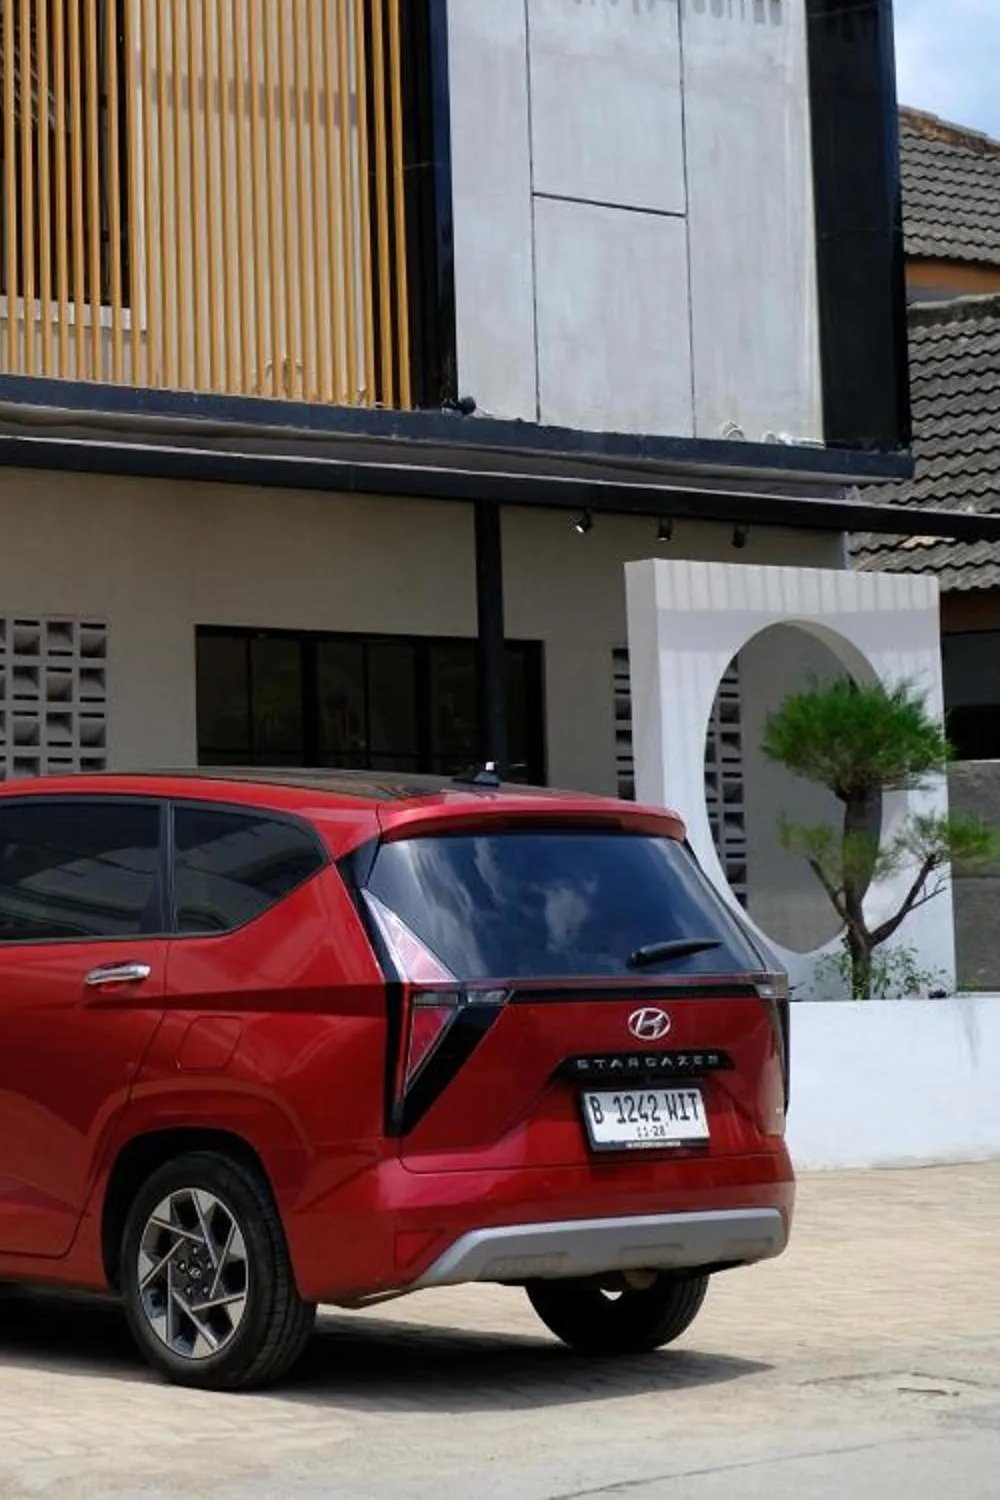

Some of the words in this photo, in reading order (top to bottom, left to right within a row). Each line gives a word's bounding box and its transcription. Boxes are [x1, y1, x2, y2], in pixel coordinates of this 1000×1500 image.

[576, 1055, 719, 1069] STARGAZER
[589, 1094, 605, 1125] B
[613, 1093, 662, 1124] 1242
